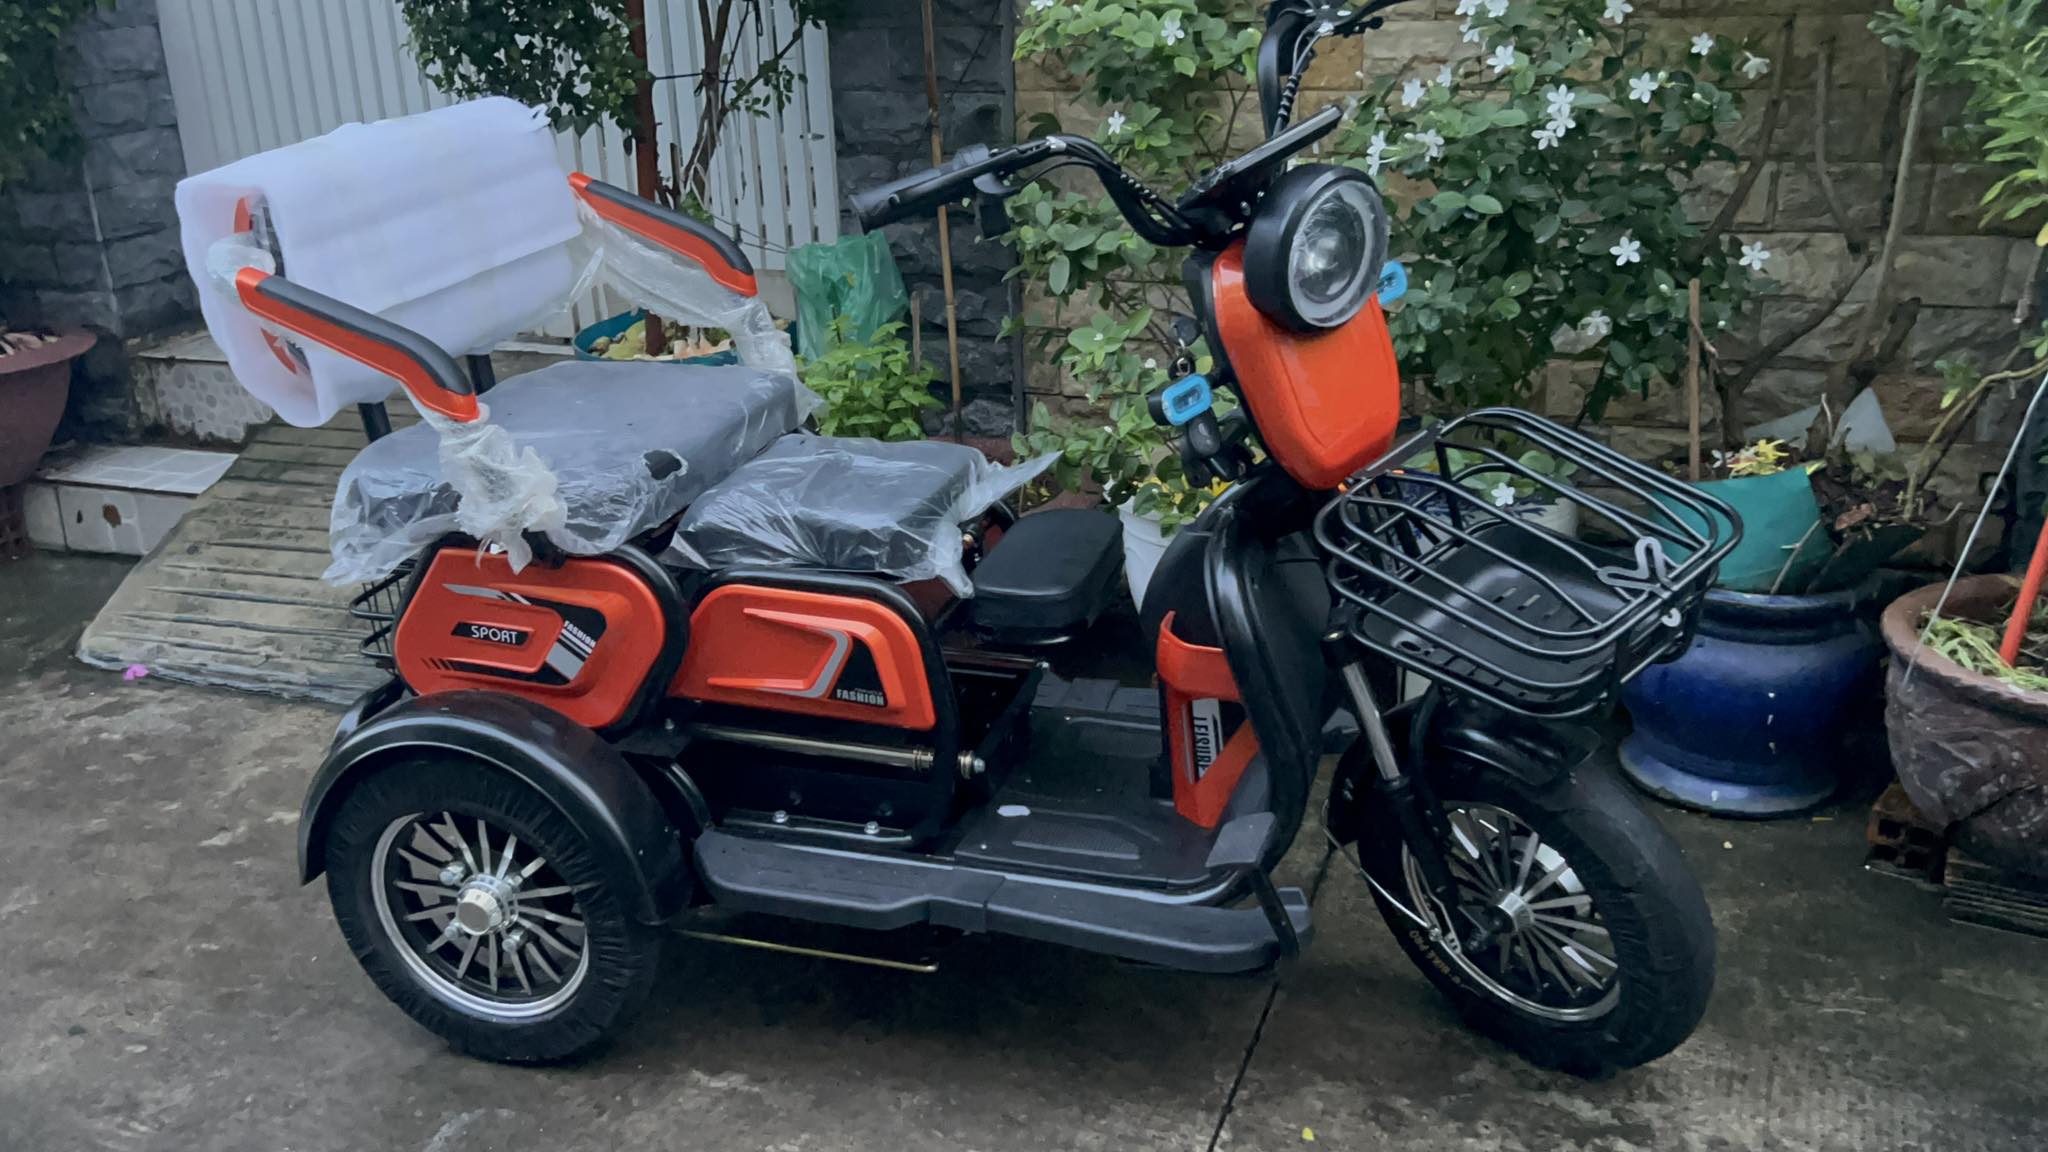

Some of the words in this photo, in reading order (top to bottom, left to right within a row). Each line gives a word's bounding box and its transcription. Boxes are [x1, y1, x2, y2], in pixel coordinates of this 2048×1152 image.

[470, 625, 518, 644] SPORT
[563, 620, 597, 648] FASHION
[836, 689, 885, 705] FASHION
